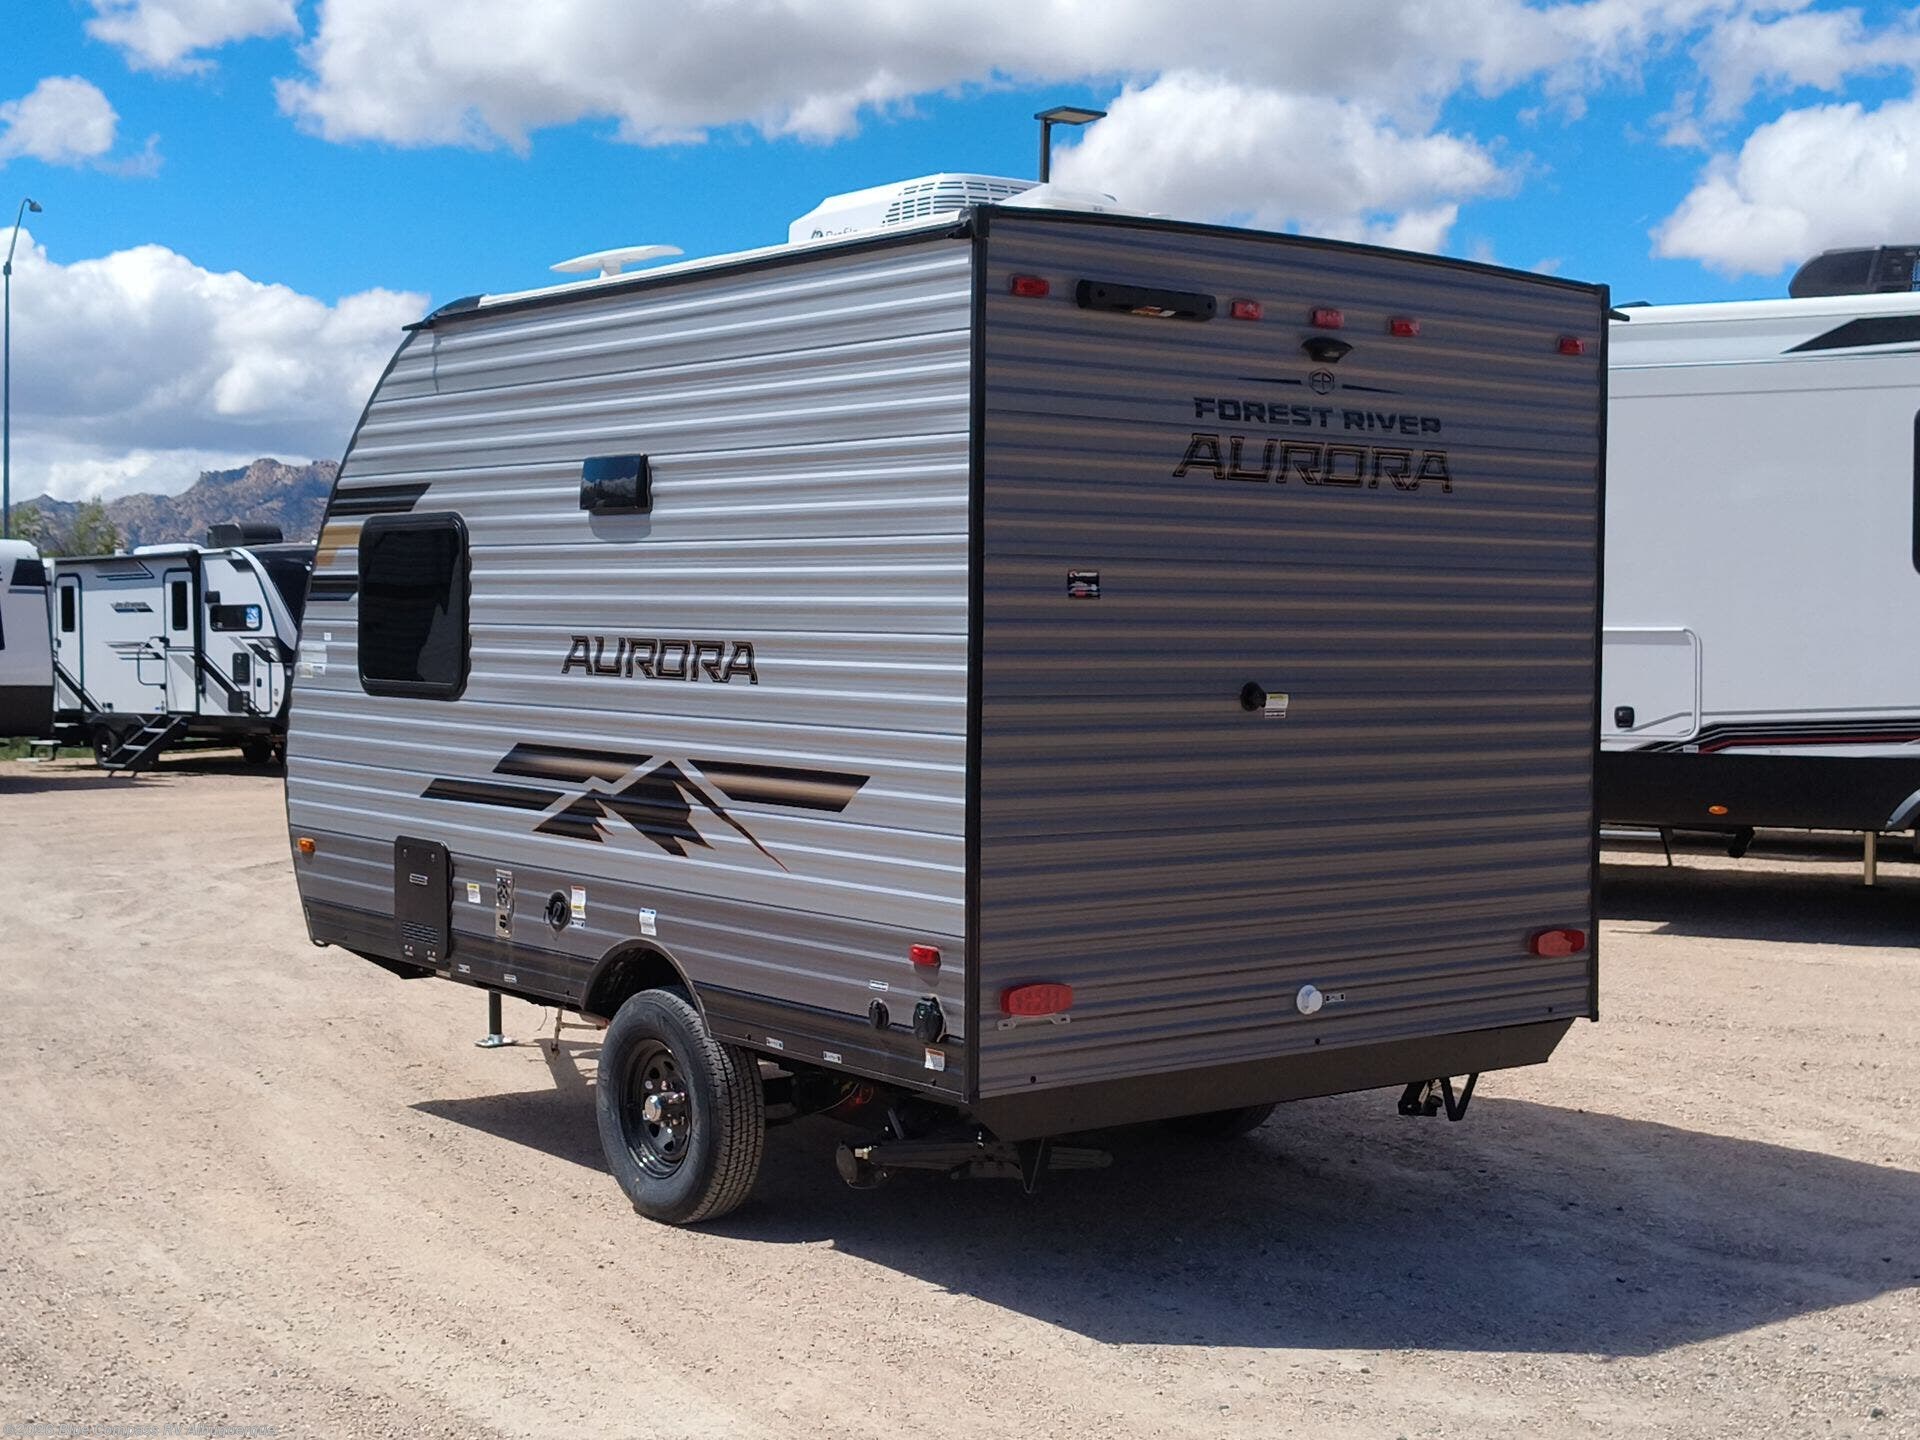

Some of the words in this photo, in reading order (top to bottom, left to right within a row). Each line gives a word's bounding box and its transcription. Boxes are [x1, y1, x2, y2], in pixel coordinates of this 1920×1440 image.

[1193, 396, 1333, 428] FOREST
[1342, 408, 1442, 435] RIVER
[1172, 432, 1453, 494] AURORA
[561, 635, 759, 685] AURORA
